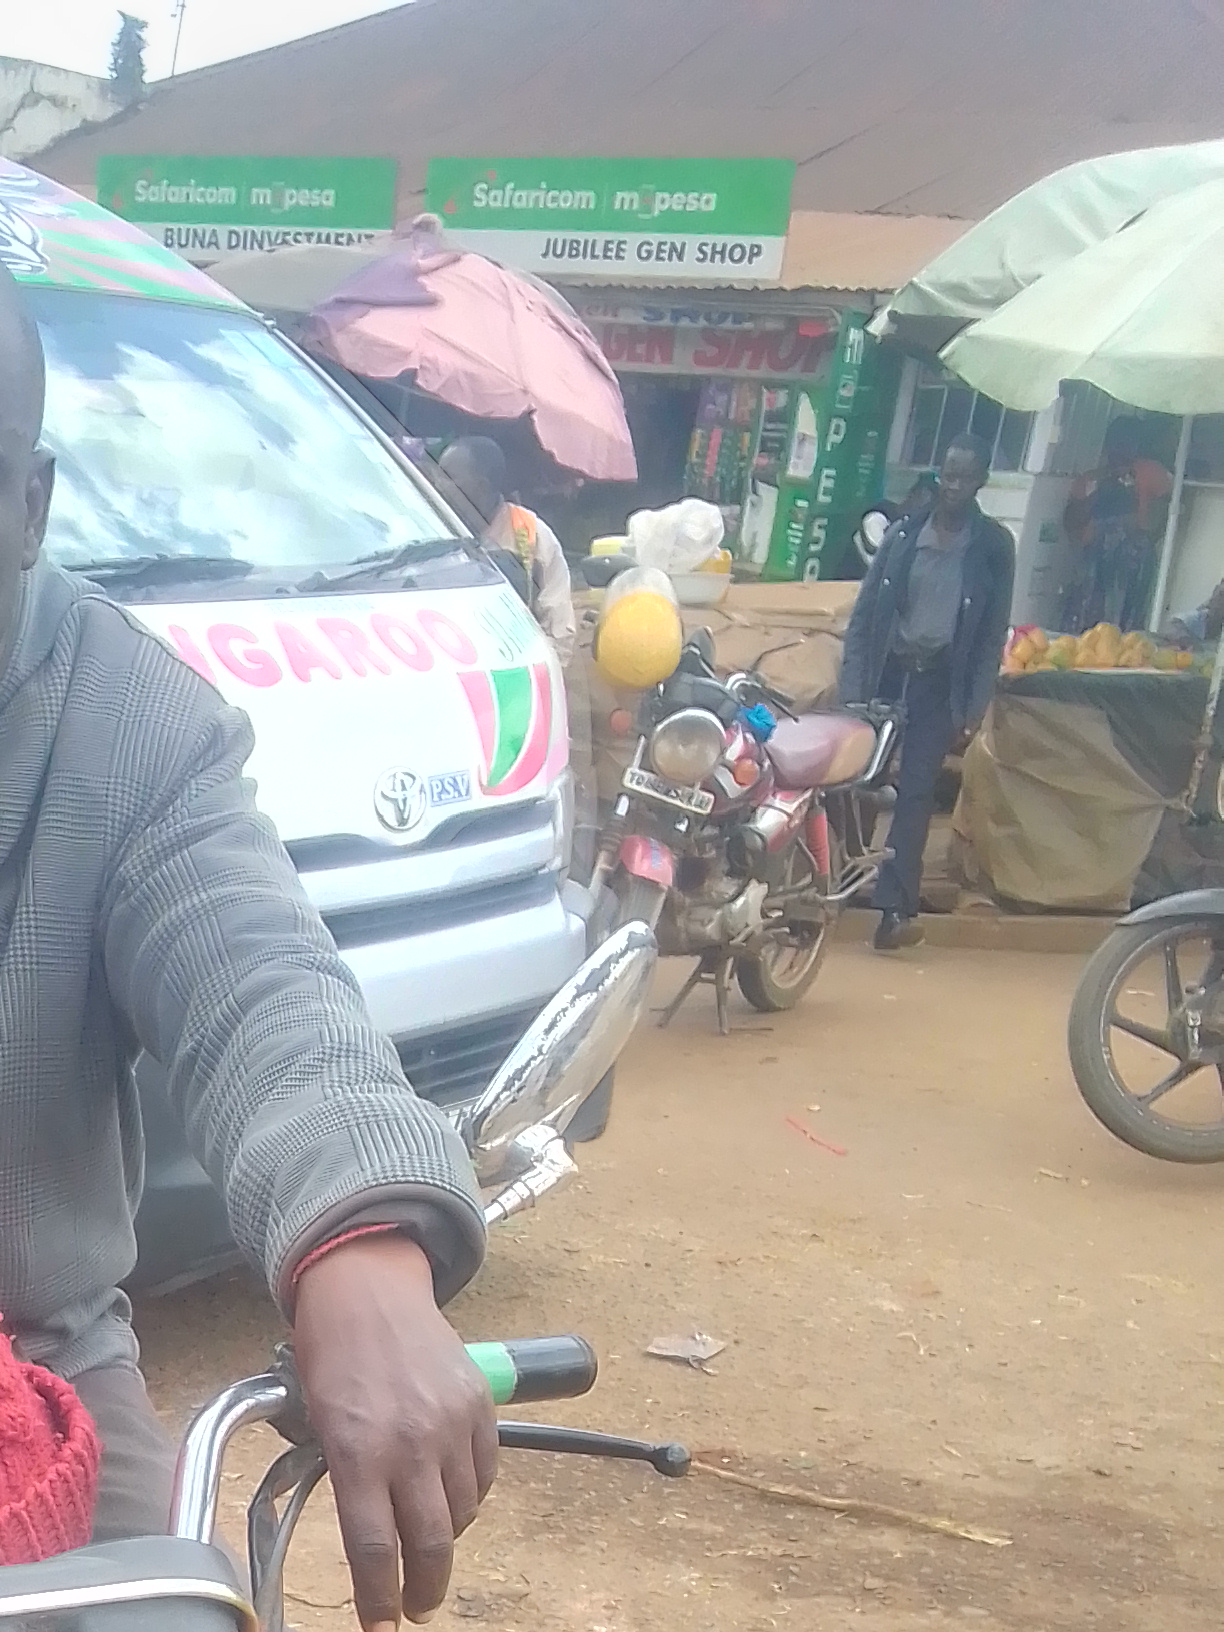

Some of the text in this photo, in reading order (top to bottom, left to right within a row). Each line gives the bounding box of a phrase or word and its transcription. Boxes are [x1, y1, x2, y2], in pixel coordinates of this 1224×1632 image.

[134, 179, 236, 205] Safaricom
[473, 181, 597, 210] Safaricom
[163, 227, 221, 250] BUNA
[540, 237, 764, 265] JUBILEE GEN SHOP
